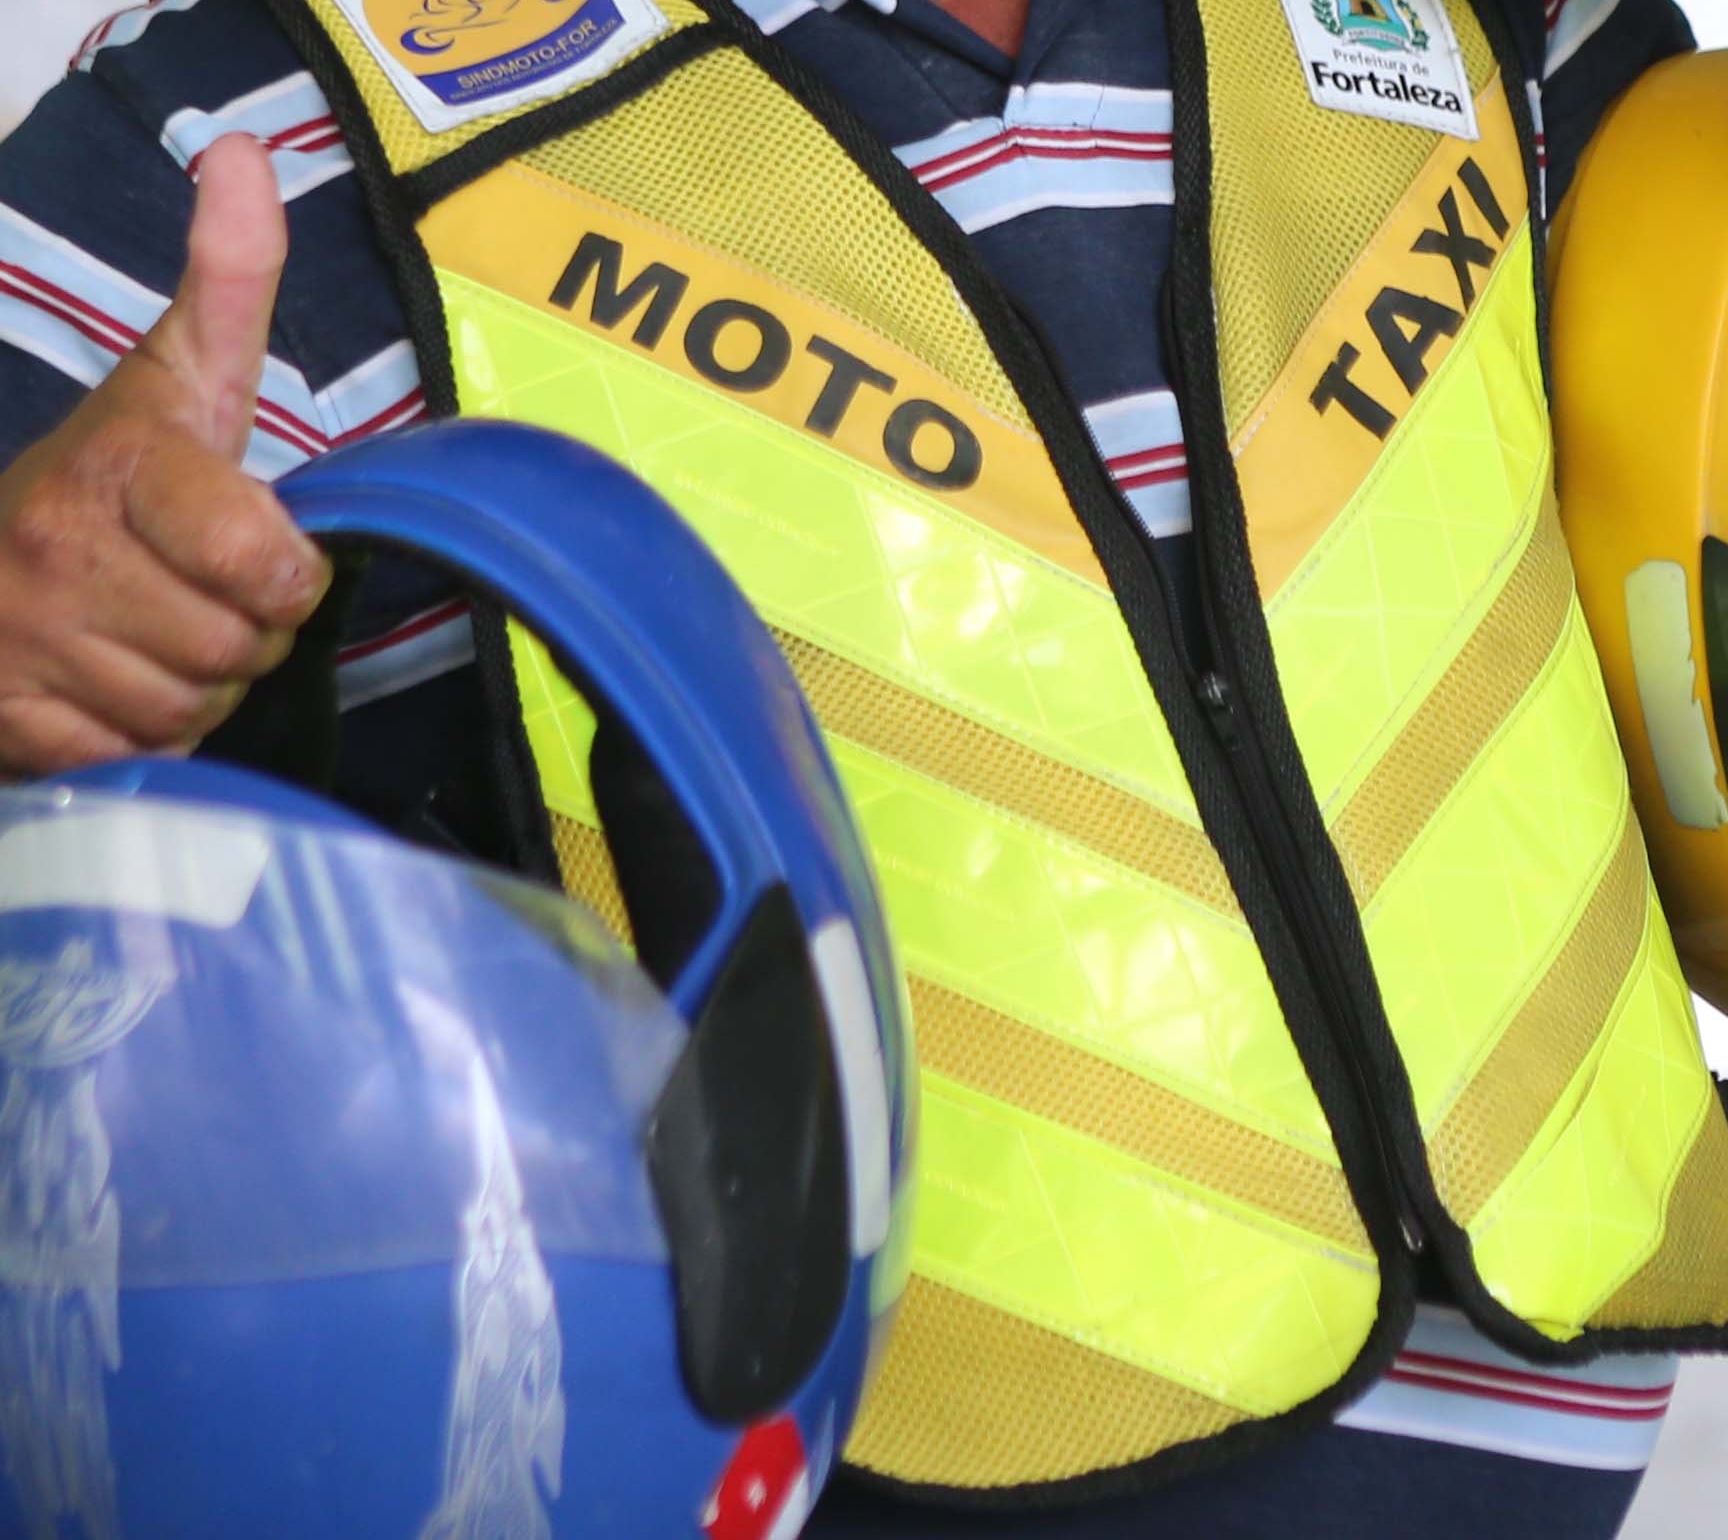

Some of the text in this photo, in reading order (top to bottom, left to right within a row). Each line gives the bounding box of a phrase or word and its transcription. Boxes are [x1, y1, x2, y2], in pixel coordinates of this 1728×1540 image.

[457, 18, 597, 90] SINDMOTO-FOR
[1311, 61, 1463, 115] Fortaleza
[1332, 48, 1430, 76] Prefeitura de
[1308, 155, 1511, 442] TAXI
[548, 231, 983, 492] MOTO
